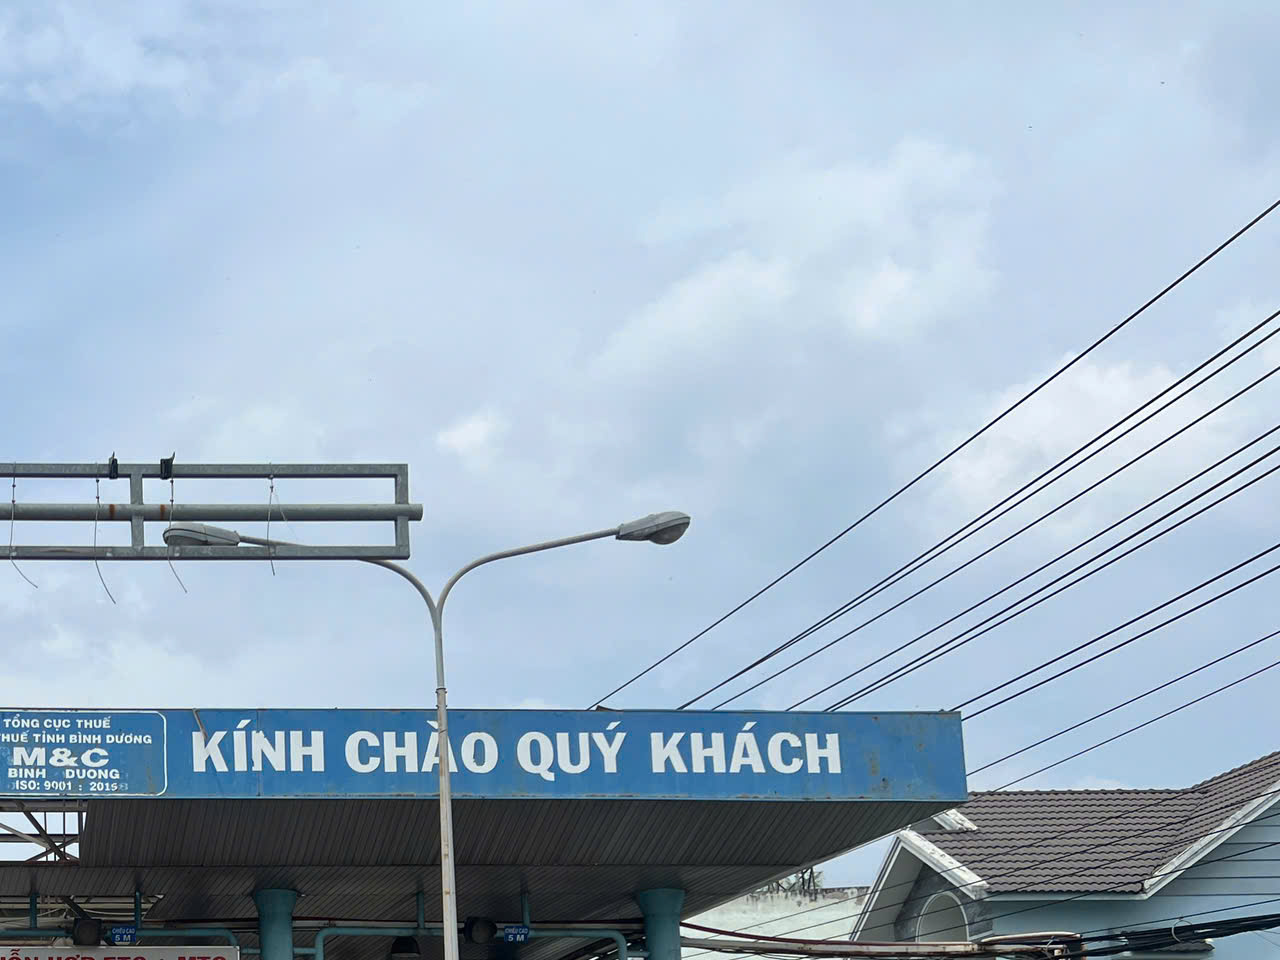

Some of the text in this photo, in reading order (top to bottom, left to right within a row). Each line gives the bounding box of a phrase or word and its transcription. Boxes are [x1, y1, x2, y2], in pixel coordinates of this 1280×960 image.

[3, 714, 112, 732] TỔNG CỤC THUẾ
[33, 731, 65, 744] TỈNH
[70, 732, 102, 744] BÌNH
[106, 733, 152, 744] DƯƠNG
[13, 746, 109, 768] M&C
[192, 719, 842, 782] KÍNH CHÀO QUÝ KHÁCH
[8, 768, 120, 779] BINH DUONG
[15, 780, 40, 790] ISO:
[44, 780, 72, 790] 9001
